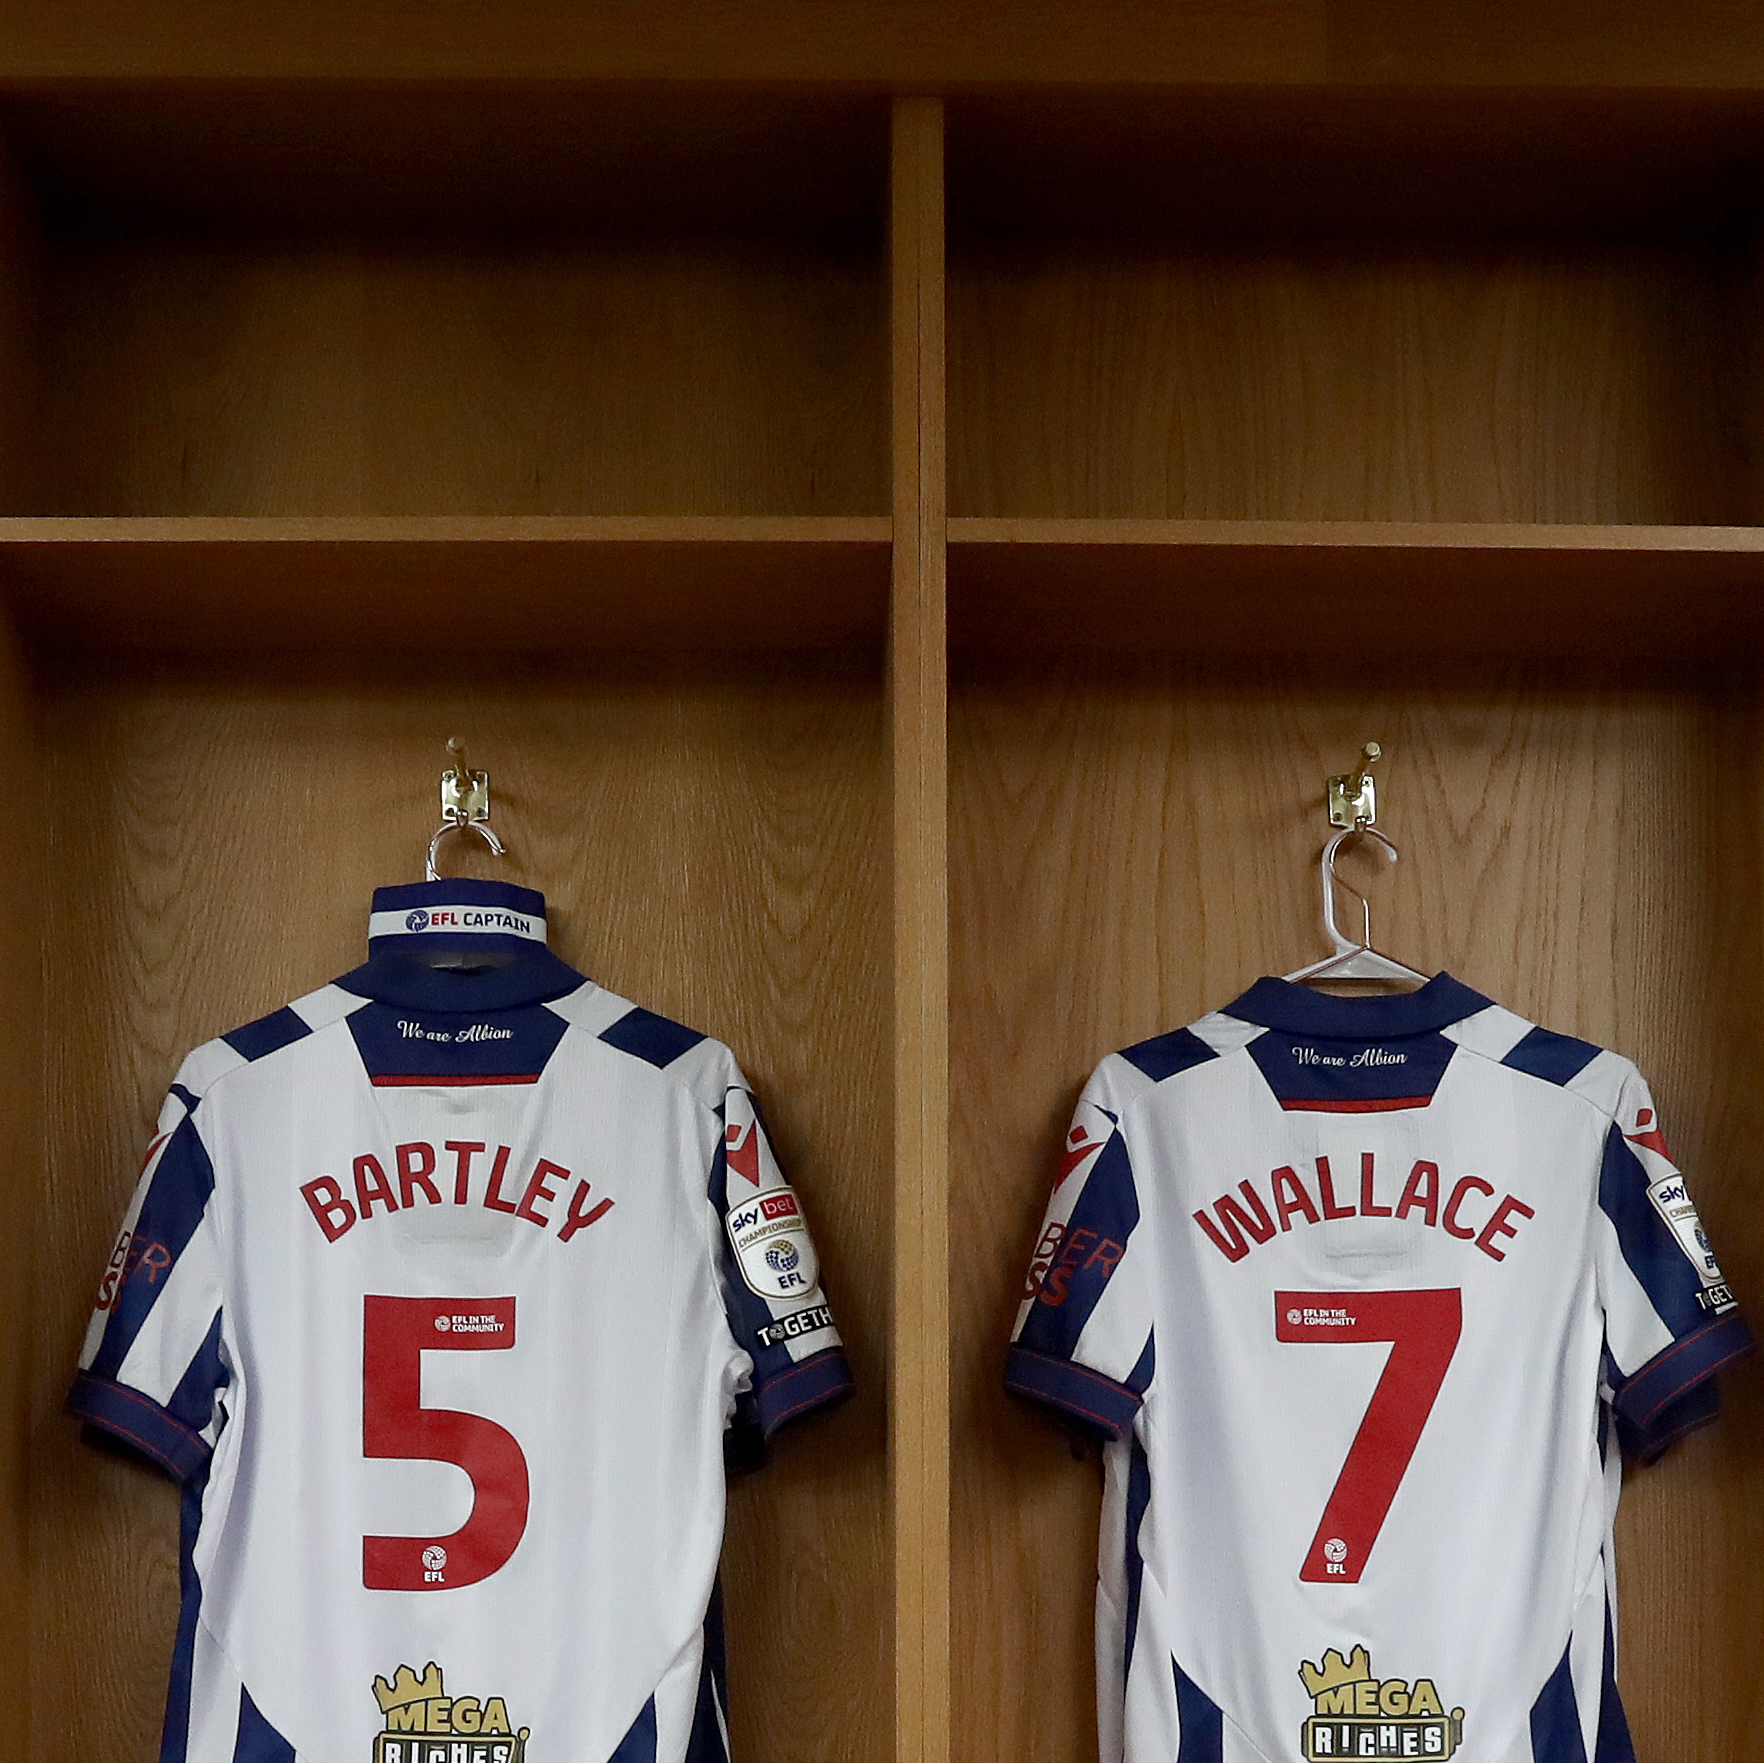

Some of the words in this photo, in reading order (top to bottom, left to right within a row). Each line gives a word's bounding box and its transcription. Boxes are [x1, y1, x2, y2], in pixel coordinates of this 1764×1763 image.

[431, 912, 459, 926] EFL
[462, 911, 531, 934] CAPTAIN
[396, 1020, 425, 1039] We
[426, 1028, 451, 1043] are
[454, 1023, 514, 1043] Albion
[1292, 1047, 1321, 1066] We
[1322, 1055, 1347, 1067] are
[1349, 1049, 1408, 1068] Albion
[299, 1141, 615, 1244] BARTLEY
[1192, 1152, 1536, 1264] WALLACE
[1659, 1185, 1686, 1204] sky
[732, 1207, 760, 1233] sky
[763, 1197, 795, 1215] bet
[777, 1272, 807, 1290] EFL
[362, 1295, 530, 1591] 5
[1274, 1287, 1463, 1584] 7
[423, 1571, 446, 1583] EFL
[1326, 1563, 1347, 1574] EFL
[1315, 1679, 1445, 1717] MEGA
[386, 1696, 512, 1735] MEGA
[1314, 1724, 1443, 1757] RICHES
